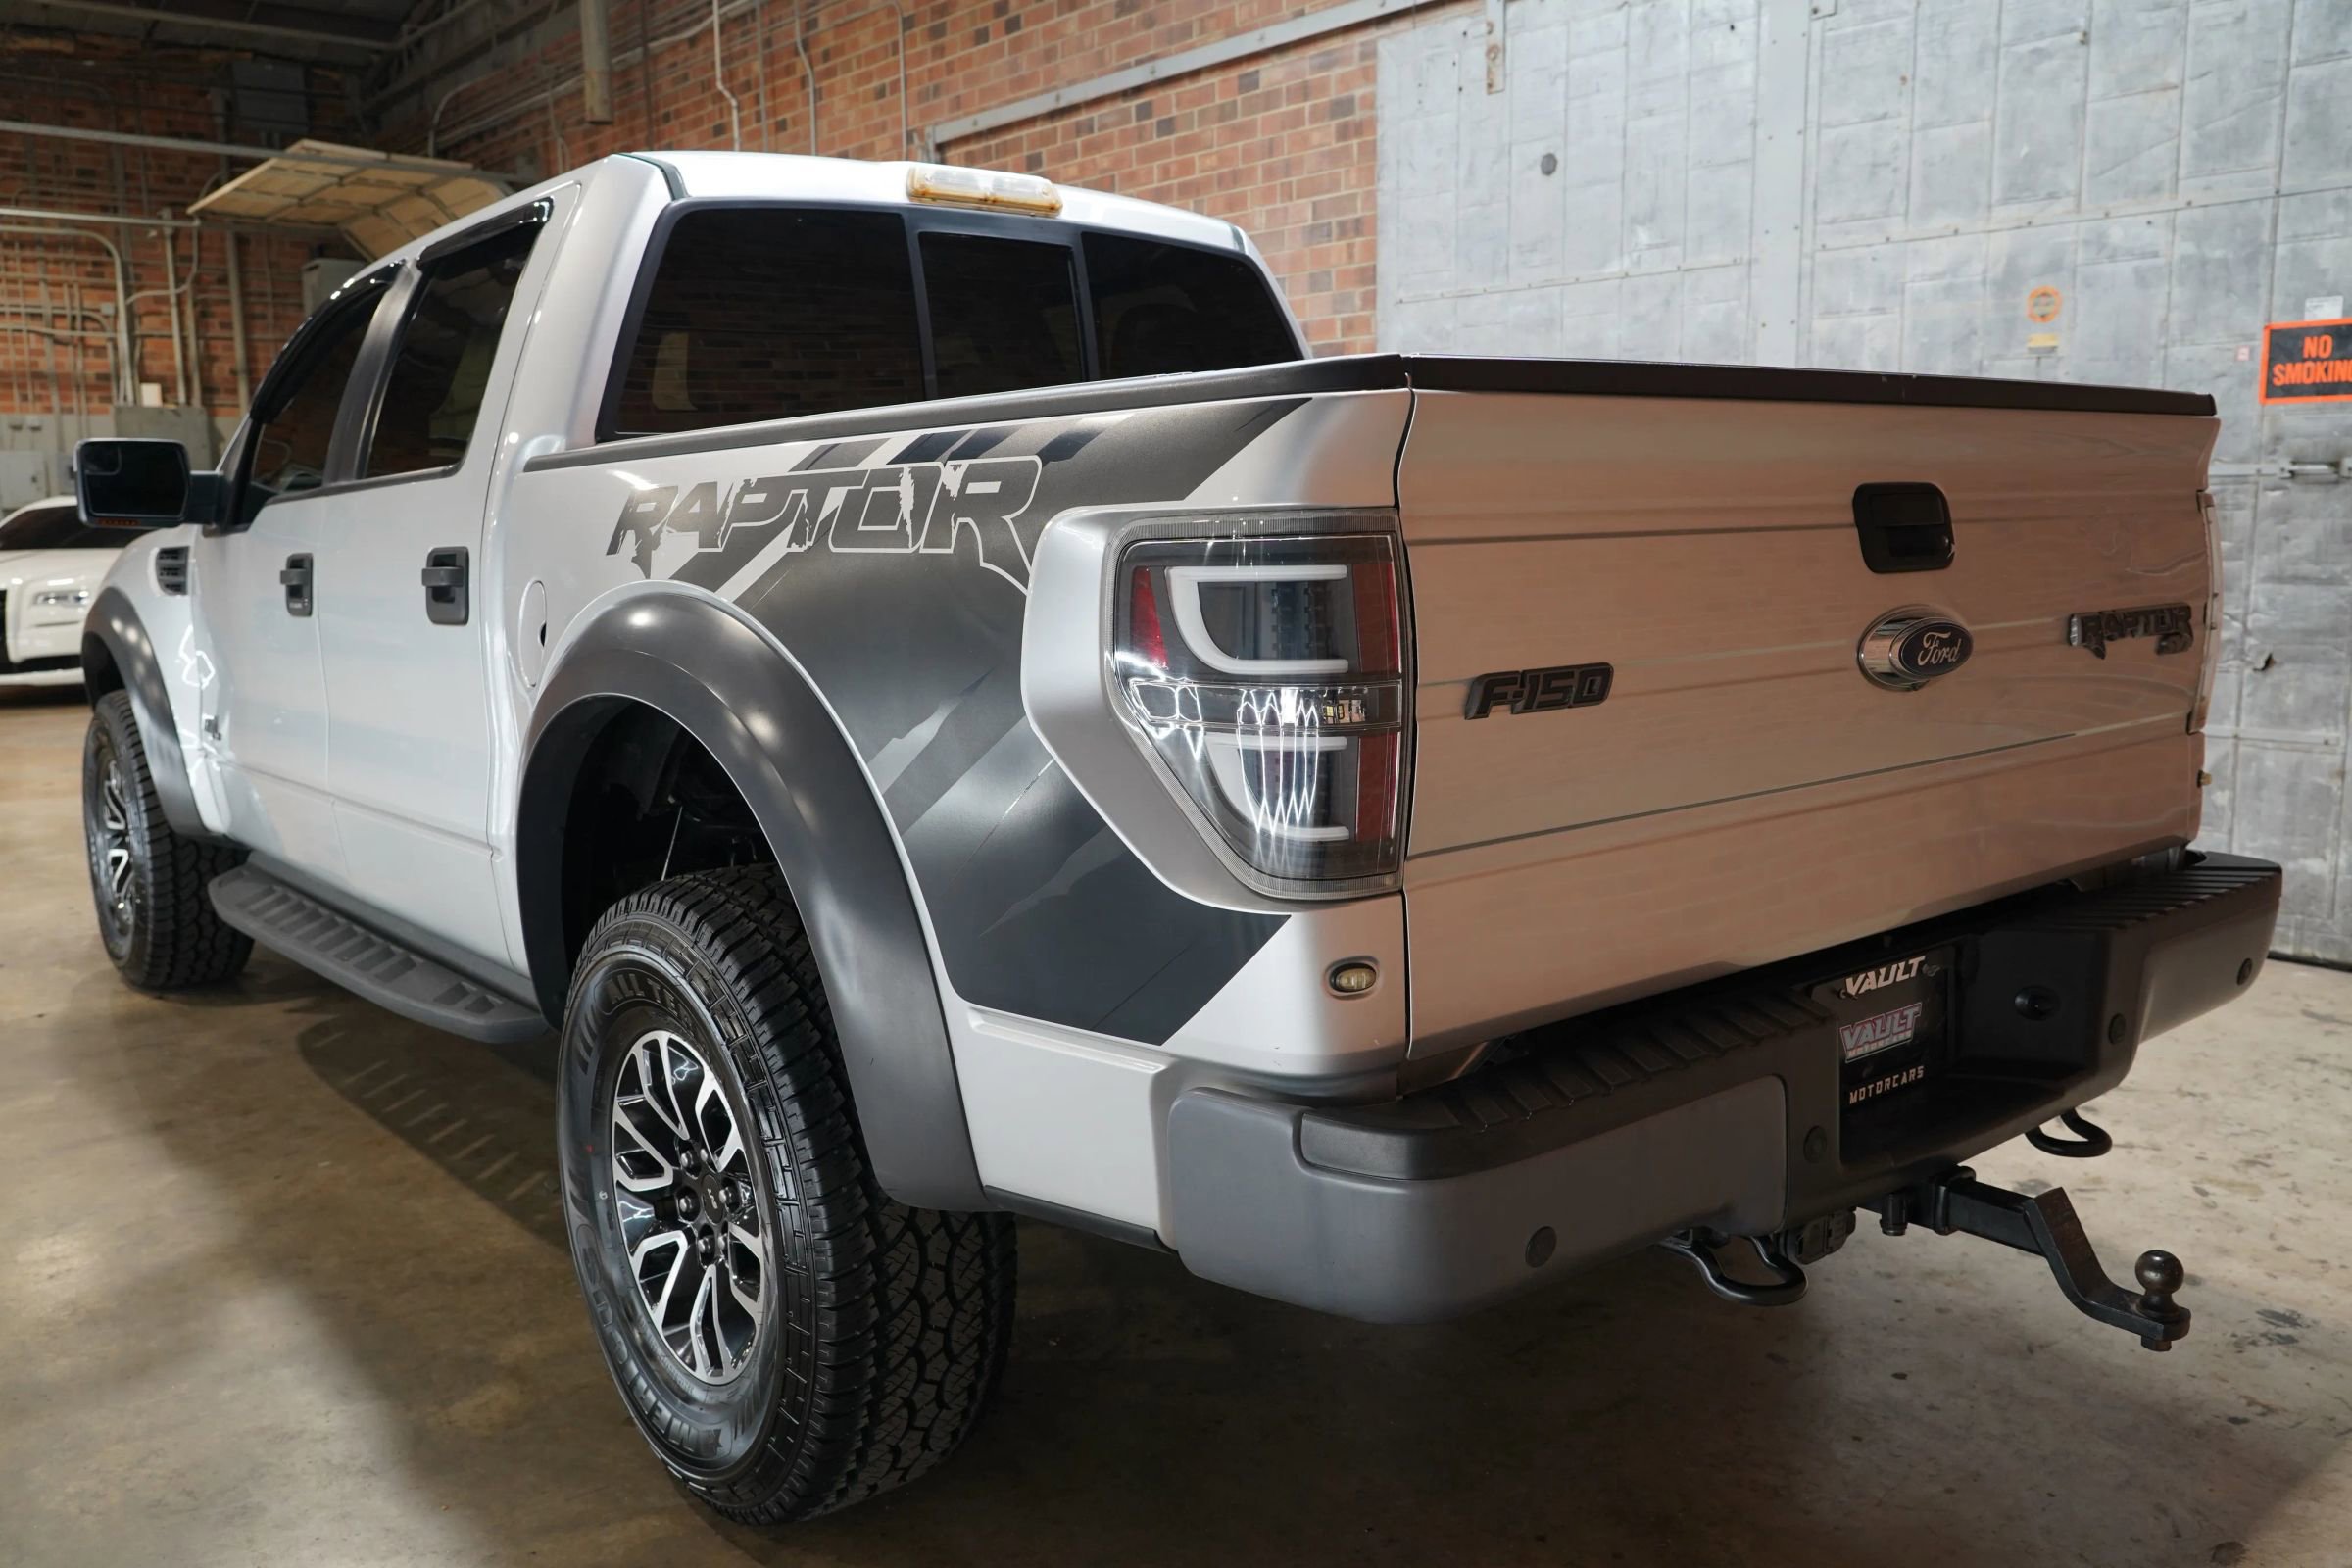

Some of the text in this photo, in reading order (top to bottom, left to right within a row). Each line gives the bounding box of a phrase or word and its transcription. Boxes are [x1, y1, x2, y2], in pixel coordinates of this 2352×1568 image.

[2303, 334, 2333, 359] NO
[2272, 359, 2352, 386] SMOKIN
[606, 455, 1043, 594] RAPTOR
[1917, 631, 1962, 666] Ford
[1465, 662, 1614, 720] F-150
[1845, 956, 1926, 996] VAULT
[1842, 1005, 1920, 1052] VAULT
[1849, 1065, 1925, 1104] MOTORCARS
